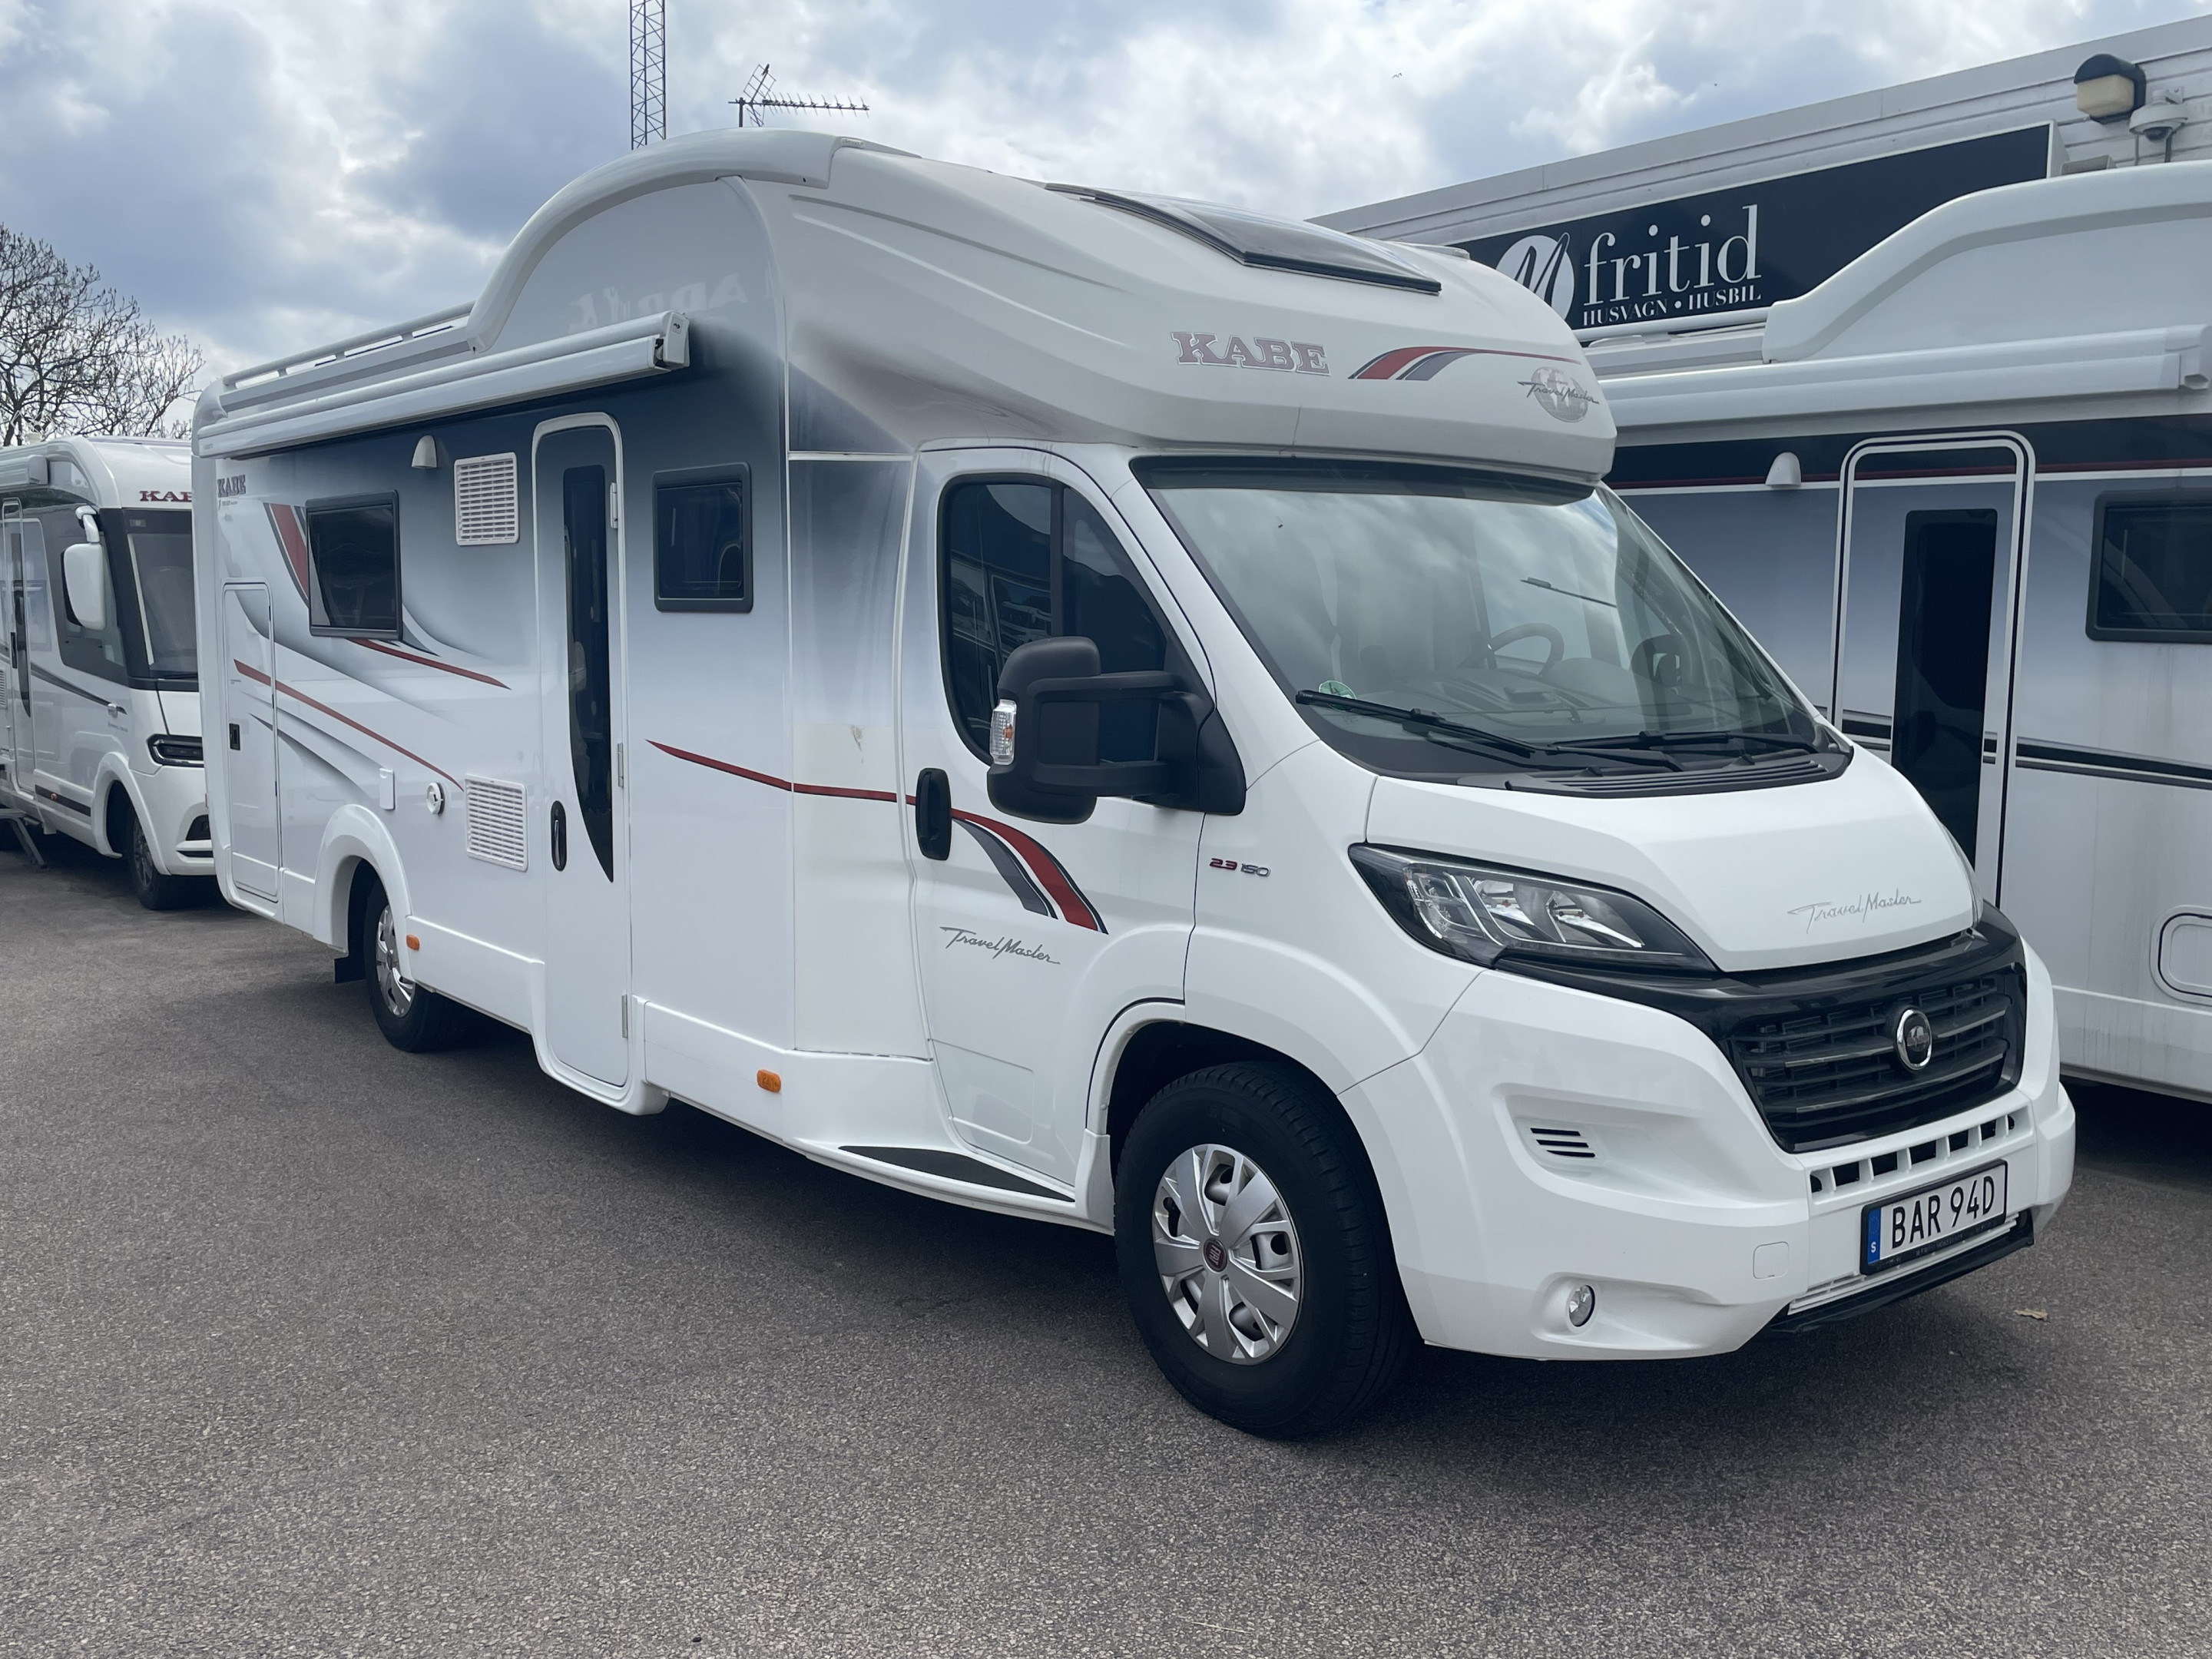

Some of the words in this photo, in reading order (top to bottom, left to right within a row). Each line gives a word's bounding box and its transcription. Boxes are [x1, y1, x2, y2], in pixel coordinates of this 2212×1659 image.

[1584, 204, 1762, 306] fritid
[1584, 299, 1668, 326] HUSVAGN
[1689, 285, 1761, 310] HUSBIL
[1170, 331, 1331, 377] KABE
[217, 475, 247, 498] KABE
[1892, 1194, 1942, 1250] BAR
[1950, 1175, 1995, 1228] 94D
[1209, 1245, 1221, 1265] FIAT
[1870, 1241, 1876, 1253] S
